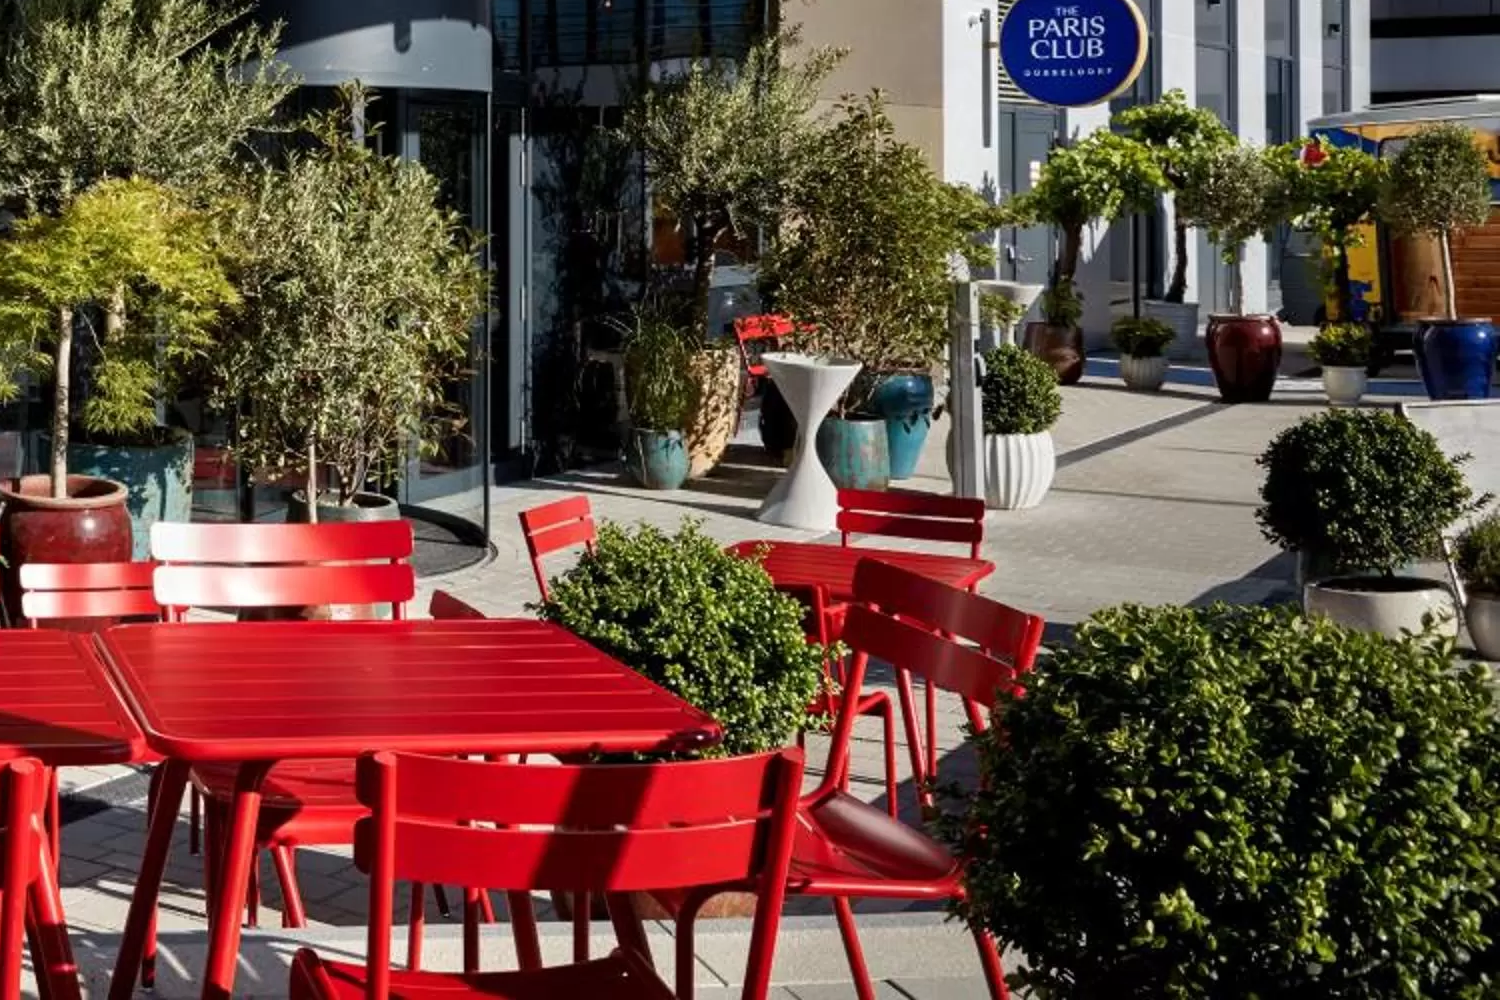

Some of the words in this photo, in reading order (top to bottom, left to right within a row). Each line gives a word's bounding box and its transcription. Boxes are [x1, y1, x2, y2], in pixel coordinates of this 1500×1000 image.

[1054, 4, 1081, 17] THE
[1028, 15, 1106, 39] PARIS
[1030, 37, 1105, 60] CLUB
